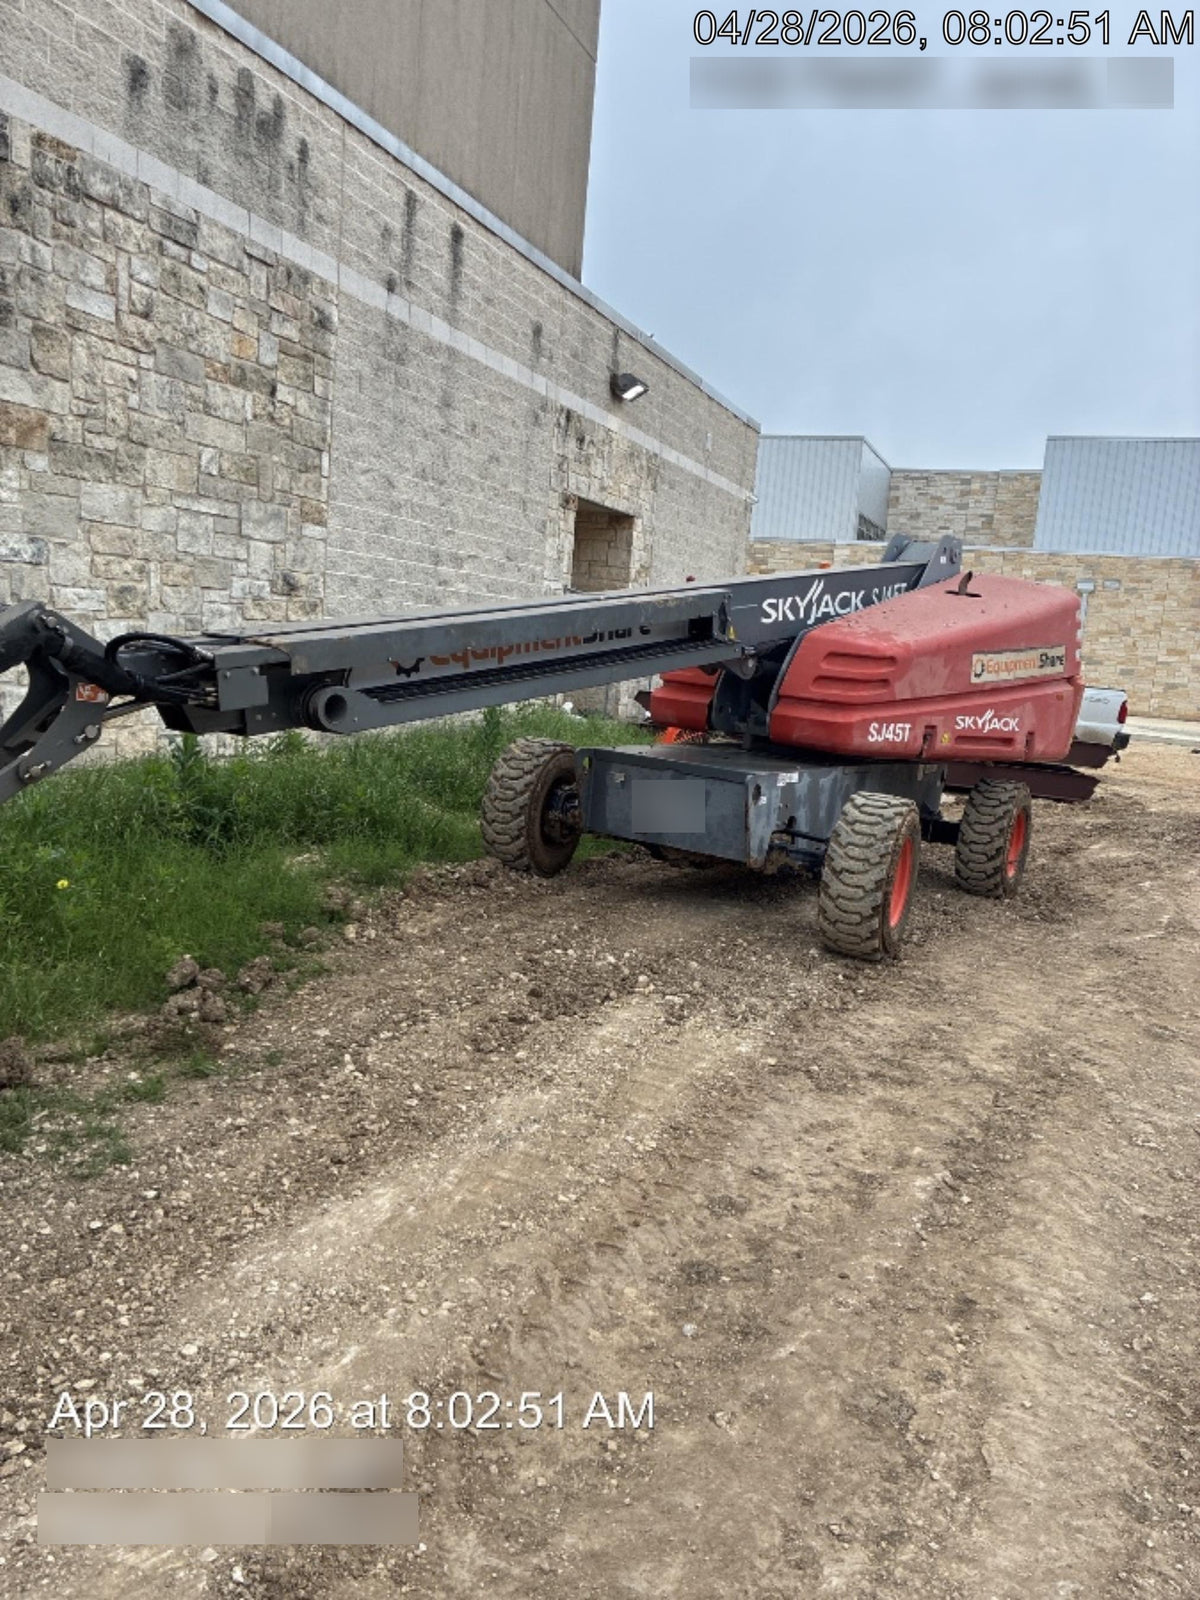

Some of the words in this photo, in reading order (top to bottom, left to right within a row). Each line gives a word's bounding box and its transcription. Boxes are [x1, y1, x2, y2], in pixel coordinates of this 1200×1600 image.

[760, 579, 866, 625] SKYJACK
[867, 721, 912, 742] SJ45T
[955, 708, 1020, 733] SKYJACK
